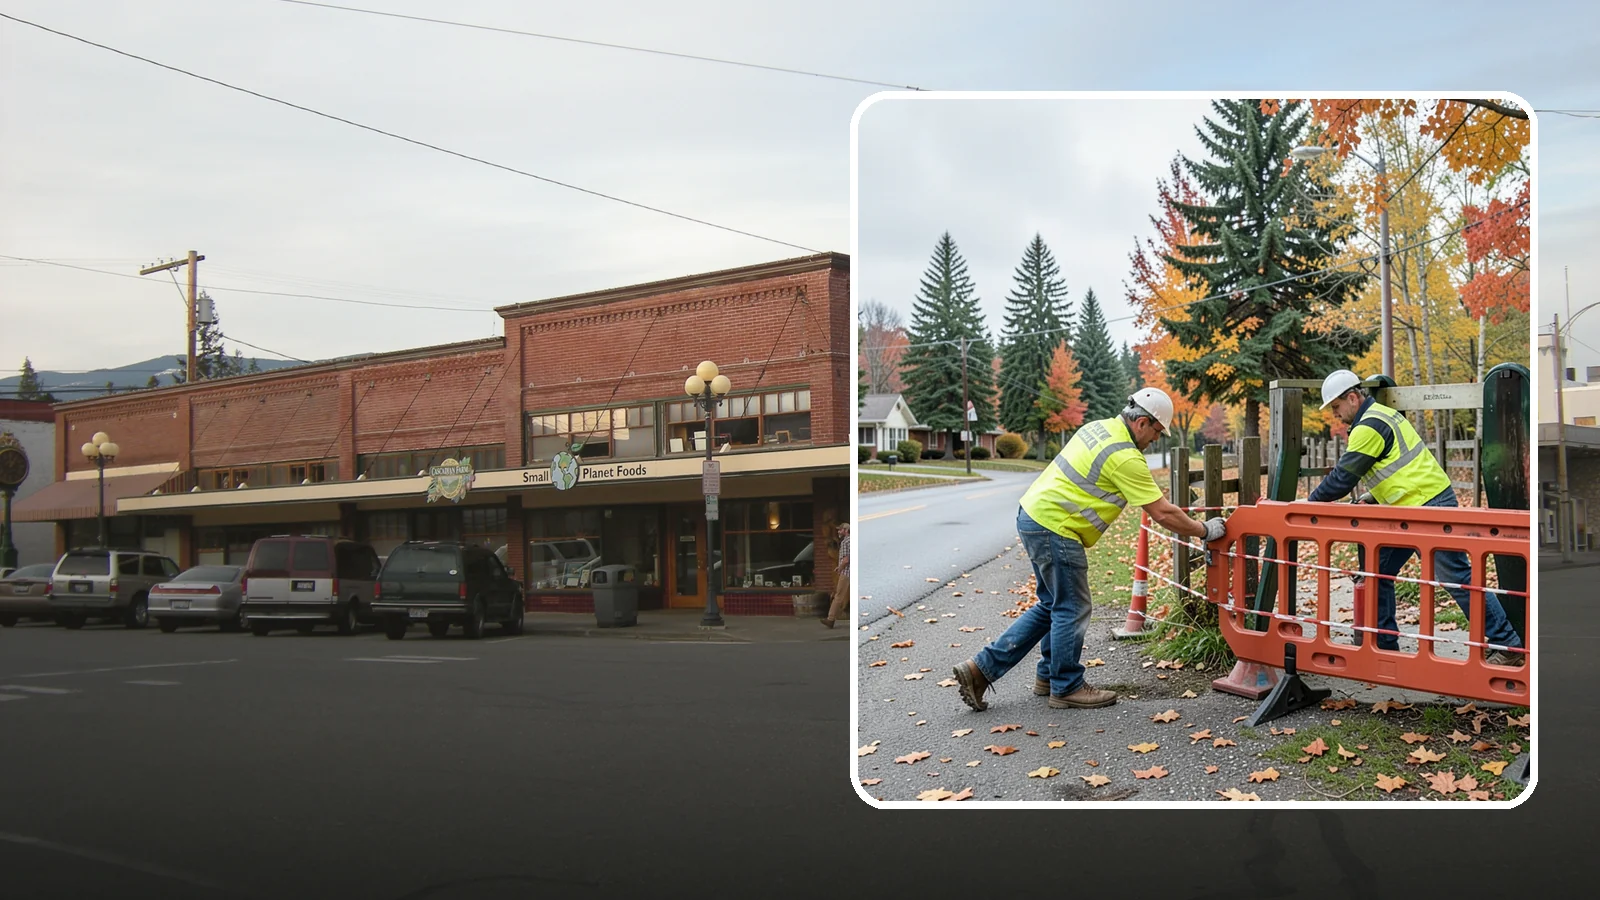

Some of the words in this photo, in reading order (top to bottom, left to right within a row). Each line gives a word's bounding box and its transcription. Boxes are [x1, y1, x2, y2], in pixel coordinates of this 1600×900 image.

[523, 471, 549, 482] Small
[583, 468, 614, 479] Planet
[617, 464, 647, 477] Foods
